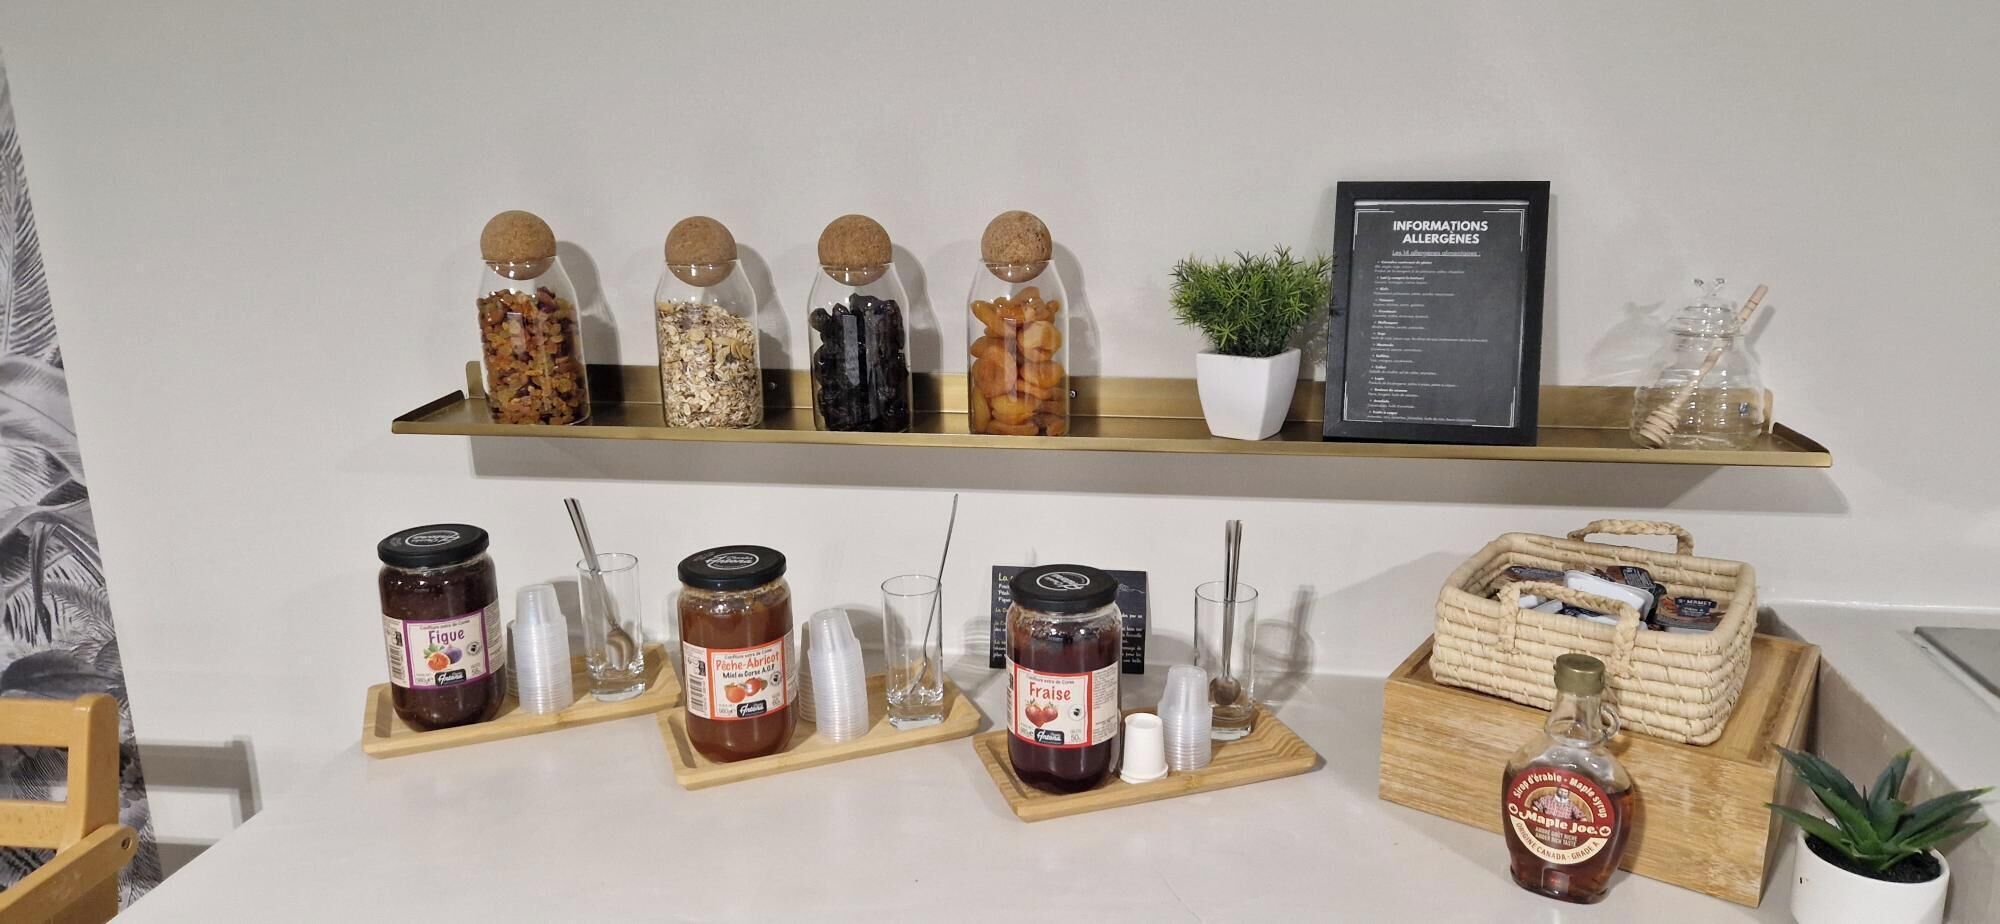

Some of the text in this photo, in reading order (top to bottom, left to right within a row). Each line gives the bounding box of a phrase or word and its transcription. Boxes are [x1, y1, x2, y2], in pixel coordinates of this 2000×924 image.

[1393, 220, 1489, 231] INFORMATIONS
[1402, 230, 1480, 244] ALLERGÈNES
[428, 630, 465, 645] Figue
[715, 651, 780, 671] Pêche-Abricot
[744, 669, 761, 677] Corse
[1029, 681, 1071, 701] Fraise
[1513, 780, 1529, 798] Sirop
[1527, 772, 1562, 785] d'érable
[1569, 777, 1595, 798] Maple
[1518, 810, 1568, 830] Maple
[1516, 822, 1536, 849] ORIGINE
[1536, 846, 1566, 860] CANADA
[1571, 846, 1594, 860] GRADE
